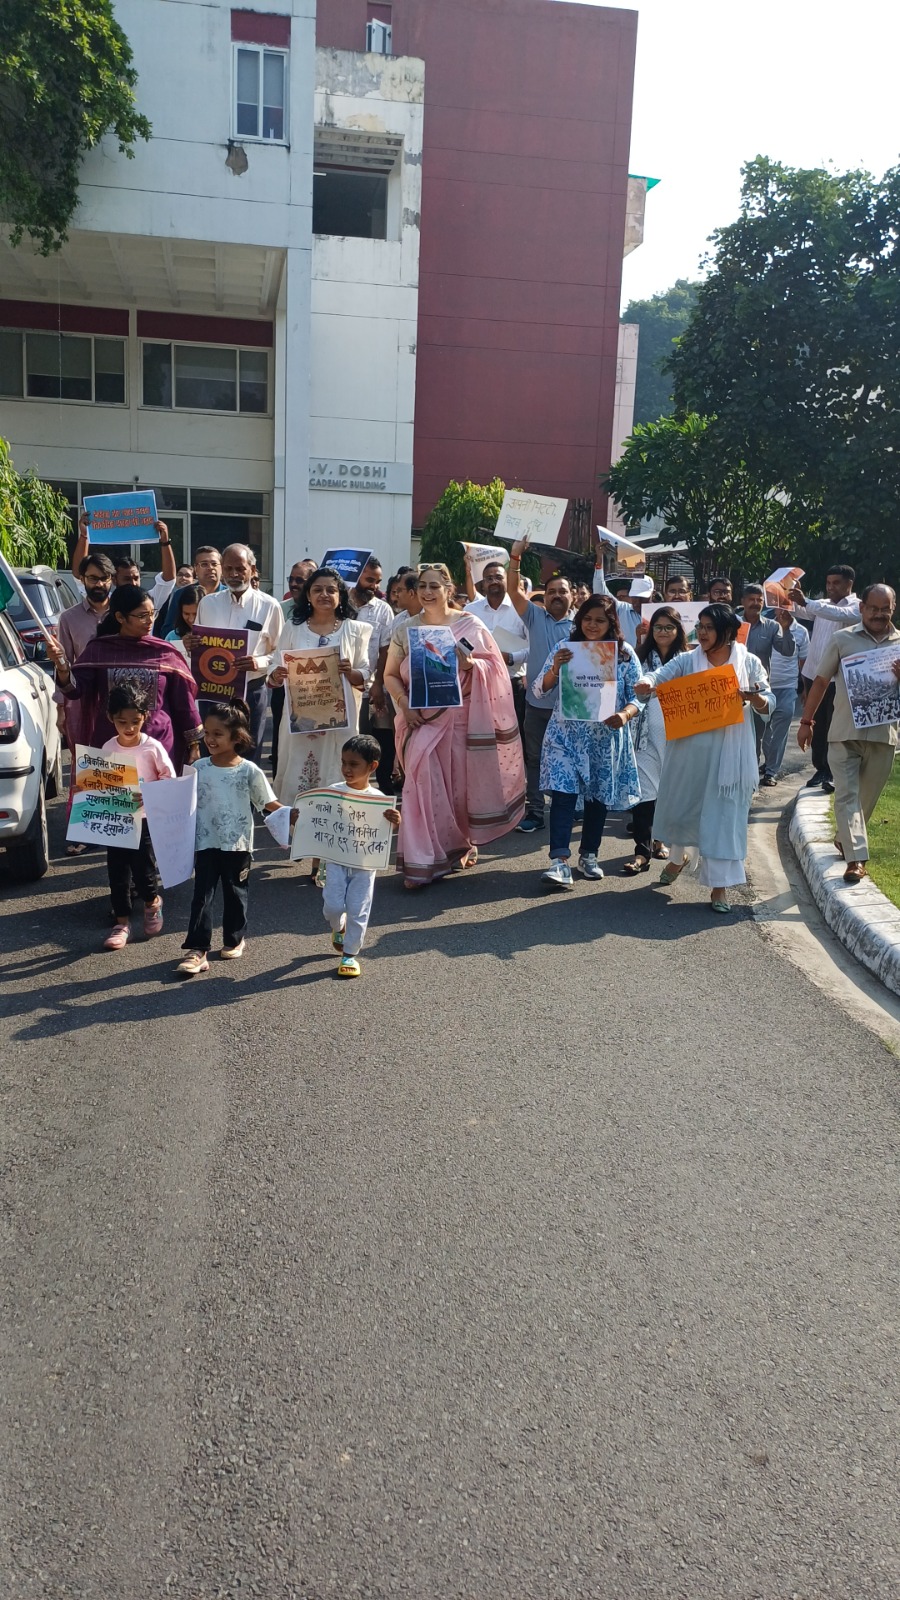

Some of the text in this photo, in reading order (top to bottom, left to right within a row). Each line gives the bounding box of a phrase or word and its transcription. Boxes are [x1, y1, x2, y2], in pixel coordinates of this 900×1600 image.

[308, 463, 387, 478] .V. DOSHI
[308, 478, 387, 490] CADEMIC BUILDING
[201, 635, 245, 650] ANKALP
[211, 660, 226, 671] SE
[200, 682, 235, 697] SIDDHI
[705, 696, 720, 712] भारत
[84, 754, 125, 772] विकसित भारत
[92, 769, 124, 783] की पहचान
[86, 794, 134, 809] सशक्त निर्माण
[81, 809, 121, 824] आत्मनिर्भर
[348, 806, 366, 821] लेकर
[90, 822, 103, 834] हर
[311, 817, 329, 828] शहर
[332, 822, 345, 833] तक
[338, 837, 349, 853] हर
